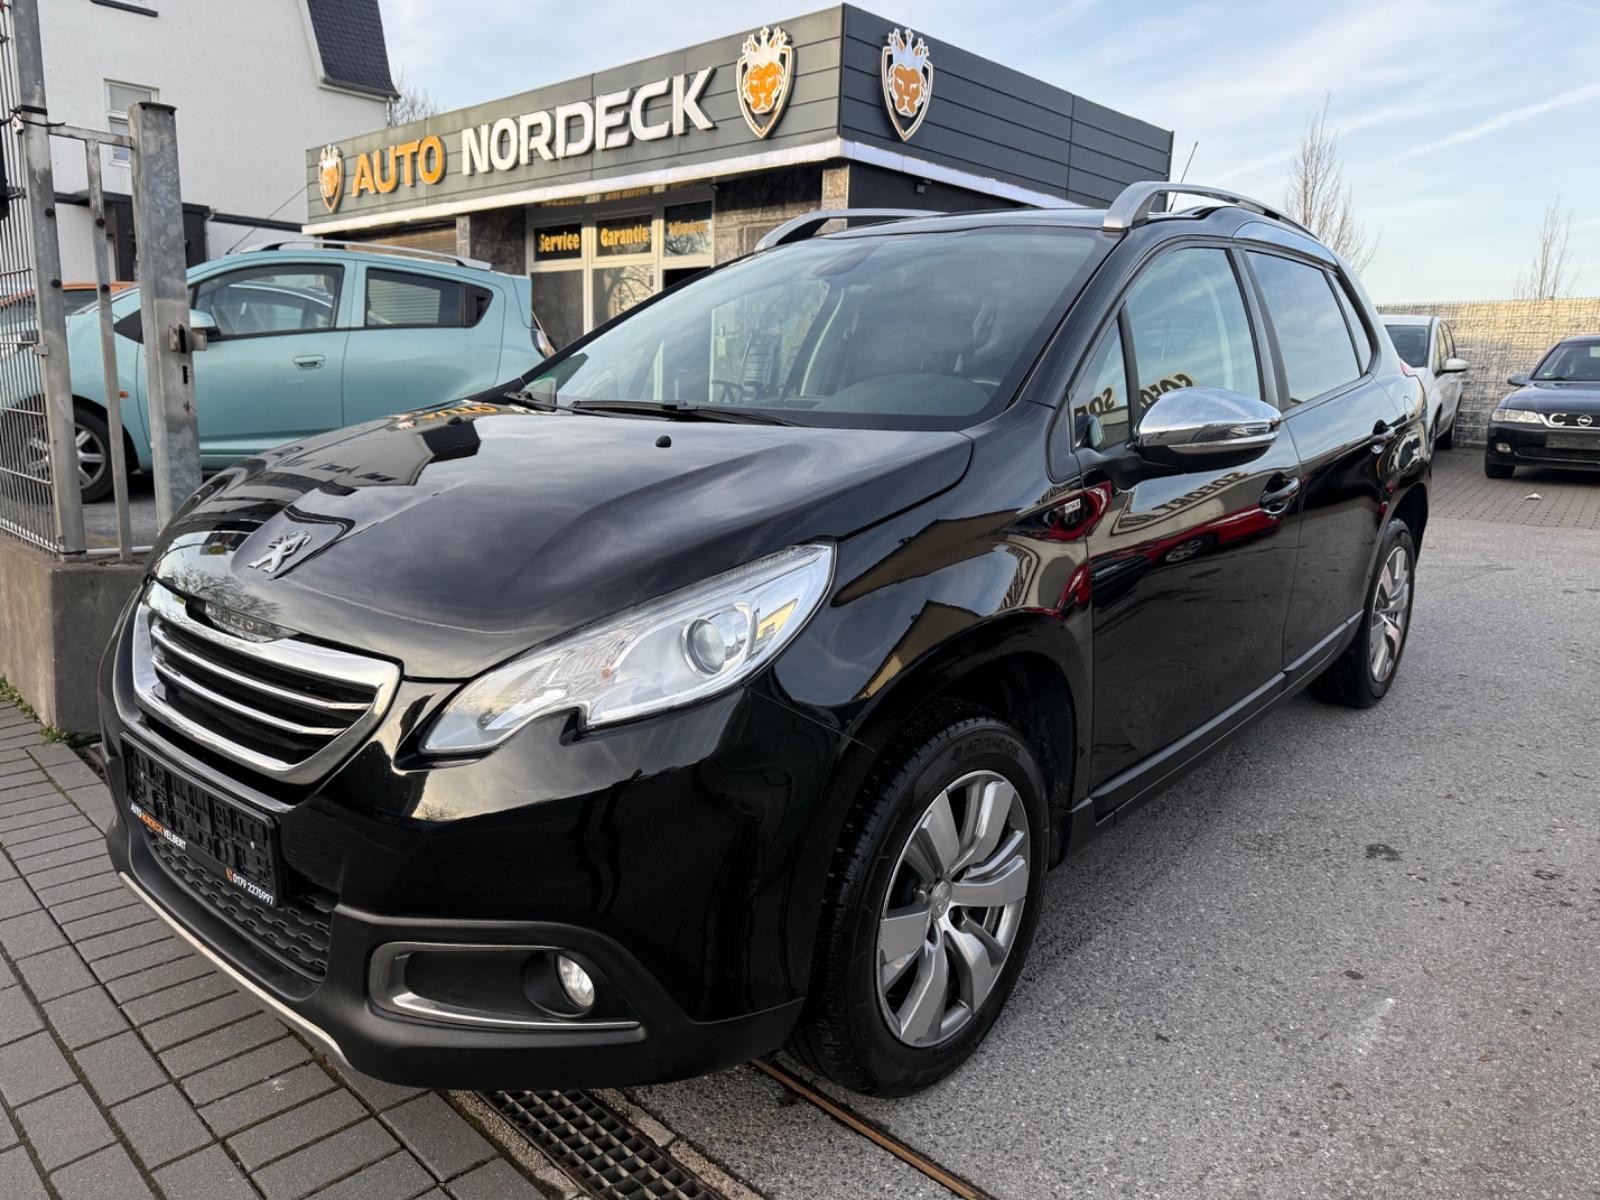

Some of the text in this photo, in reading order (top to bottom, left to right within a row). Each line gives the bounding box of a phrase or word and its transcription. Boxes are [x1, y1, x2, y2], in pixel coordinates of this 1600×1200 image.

[352, 66, 717, 197] AUTO NORDECK
[539, 232, 580, 252] Service
[601, 224, 649, 247] Garantie
[208, 605, 263, 634] PEUGEOT
[131, 802, 142, 818] AUTO
[163, 828, 187, 851] VELBERT
